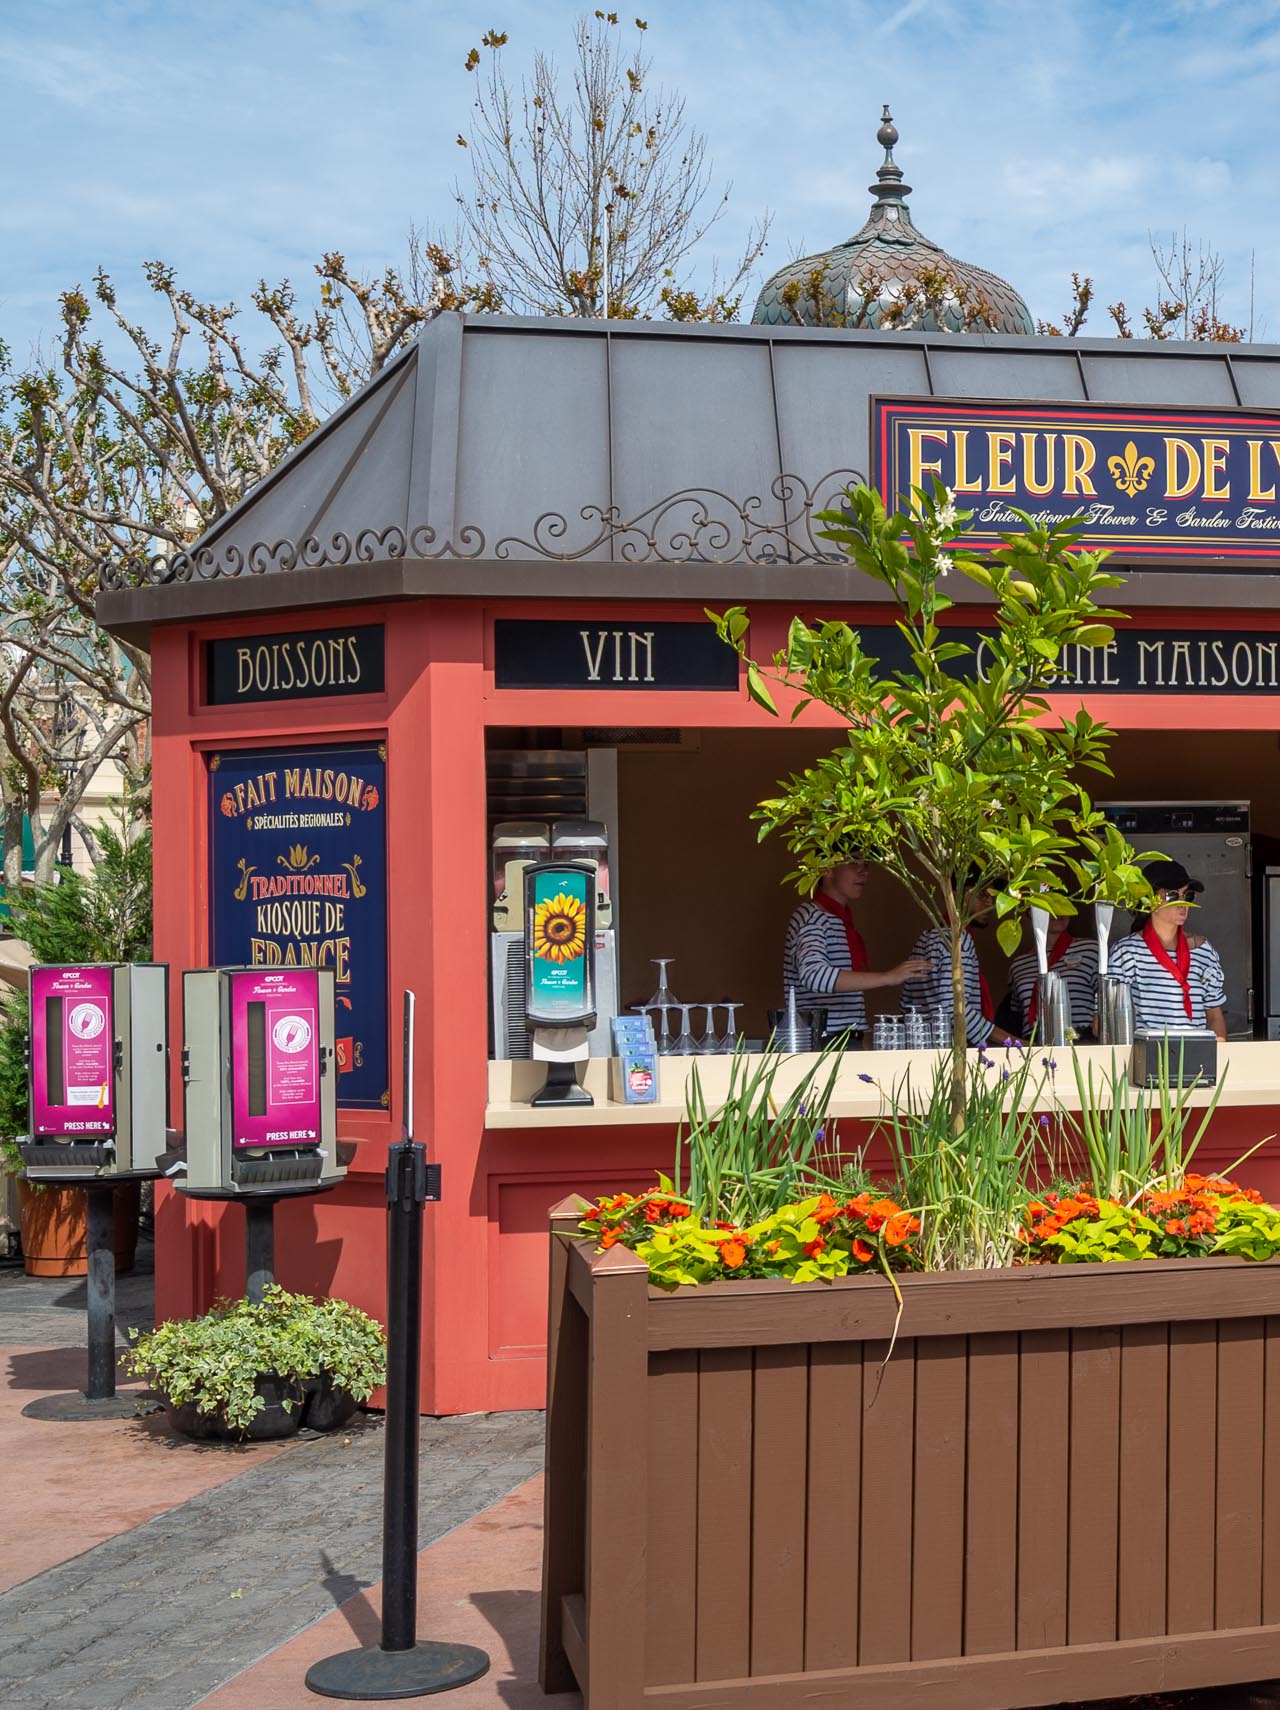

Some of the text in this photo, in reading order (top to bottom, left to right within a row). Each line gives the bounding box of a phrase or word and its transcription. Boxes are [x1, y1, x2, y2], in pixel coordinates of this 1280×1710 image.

[907, 428, 1098, 526] FLEUR
[1163, 437, 1231, 502] DE
[1083, 502, 1139, 527] Flower
[1146, 507, 1168, 527] &
[1175, 506, 1232, 528] Garden
[236, 635, 361, 694] BOISSONS
[580, 631, 655, 681] VIN
[1137, 640, 1279, 687] MAISON
[234, 767, 364, 814] FAIT MAISON
[299, 812, 344, 828] REGIONALES
[250, 873, 351, 901] TRADITIONNEL
[257, 900, 345, 939] KIOSQUE DE
[64, 1122, 85, 1131] PRESS
[85, 1121, 102, 1130] HERE
[266, 1131, 289, 1141] PRESS
[289, 1130, 308, 1139] HERE
